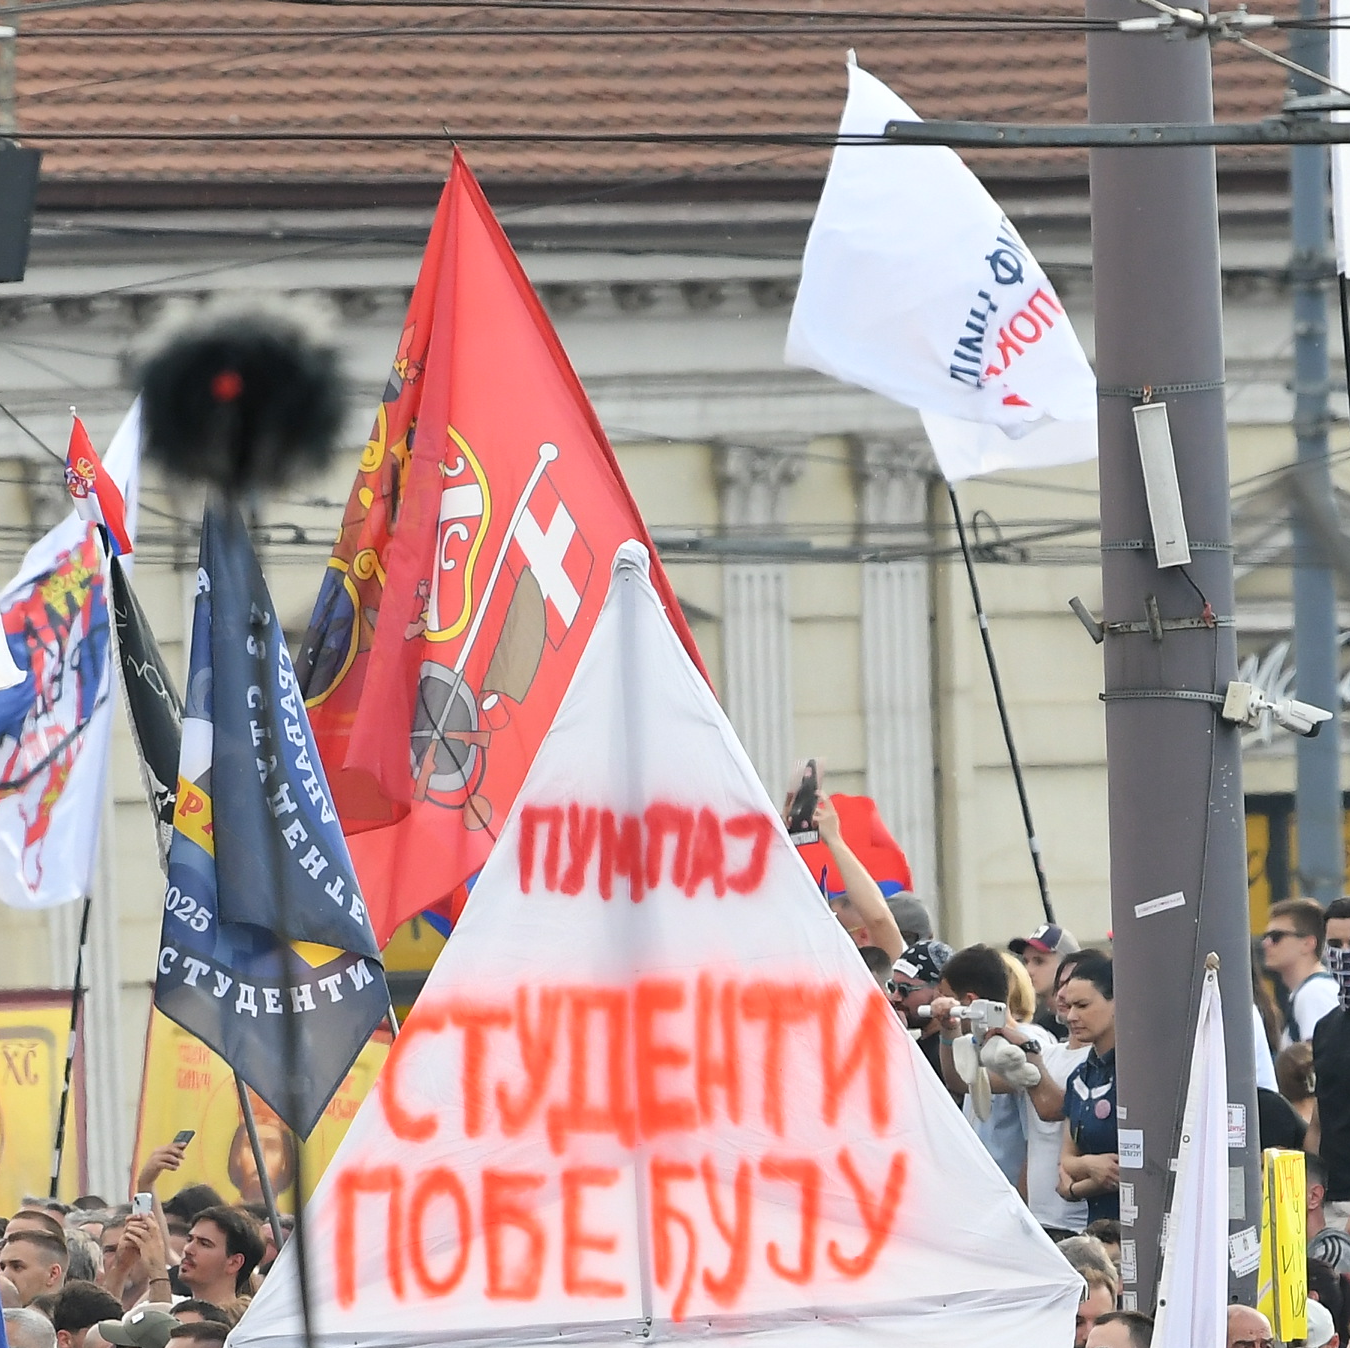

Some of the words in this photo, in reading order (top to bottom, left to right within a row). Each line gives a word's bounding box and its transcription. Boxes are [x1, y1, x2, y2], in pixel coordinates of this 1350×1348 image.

[518, 804, 773, 904] ПУМПАЈ
[158, 945, 374, 1018] СТУДЕНТИ
[383, 977, 892, 1154] СТУДЕНТИ
[333, 1150, 907, 1322] ПОБЕЂУЈУ
